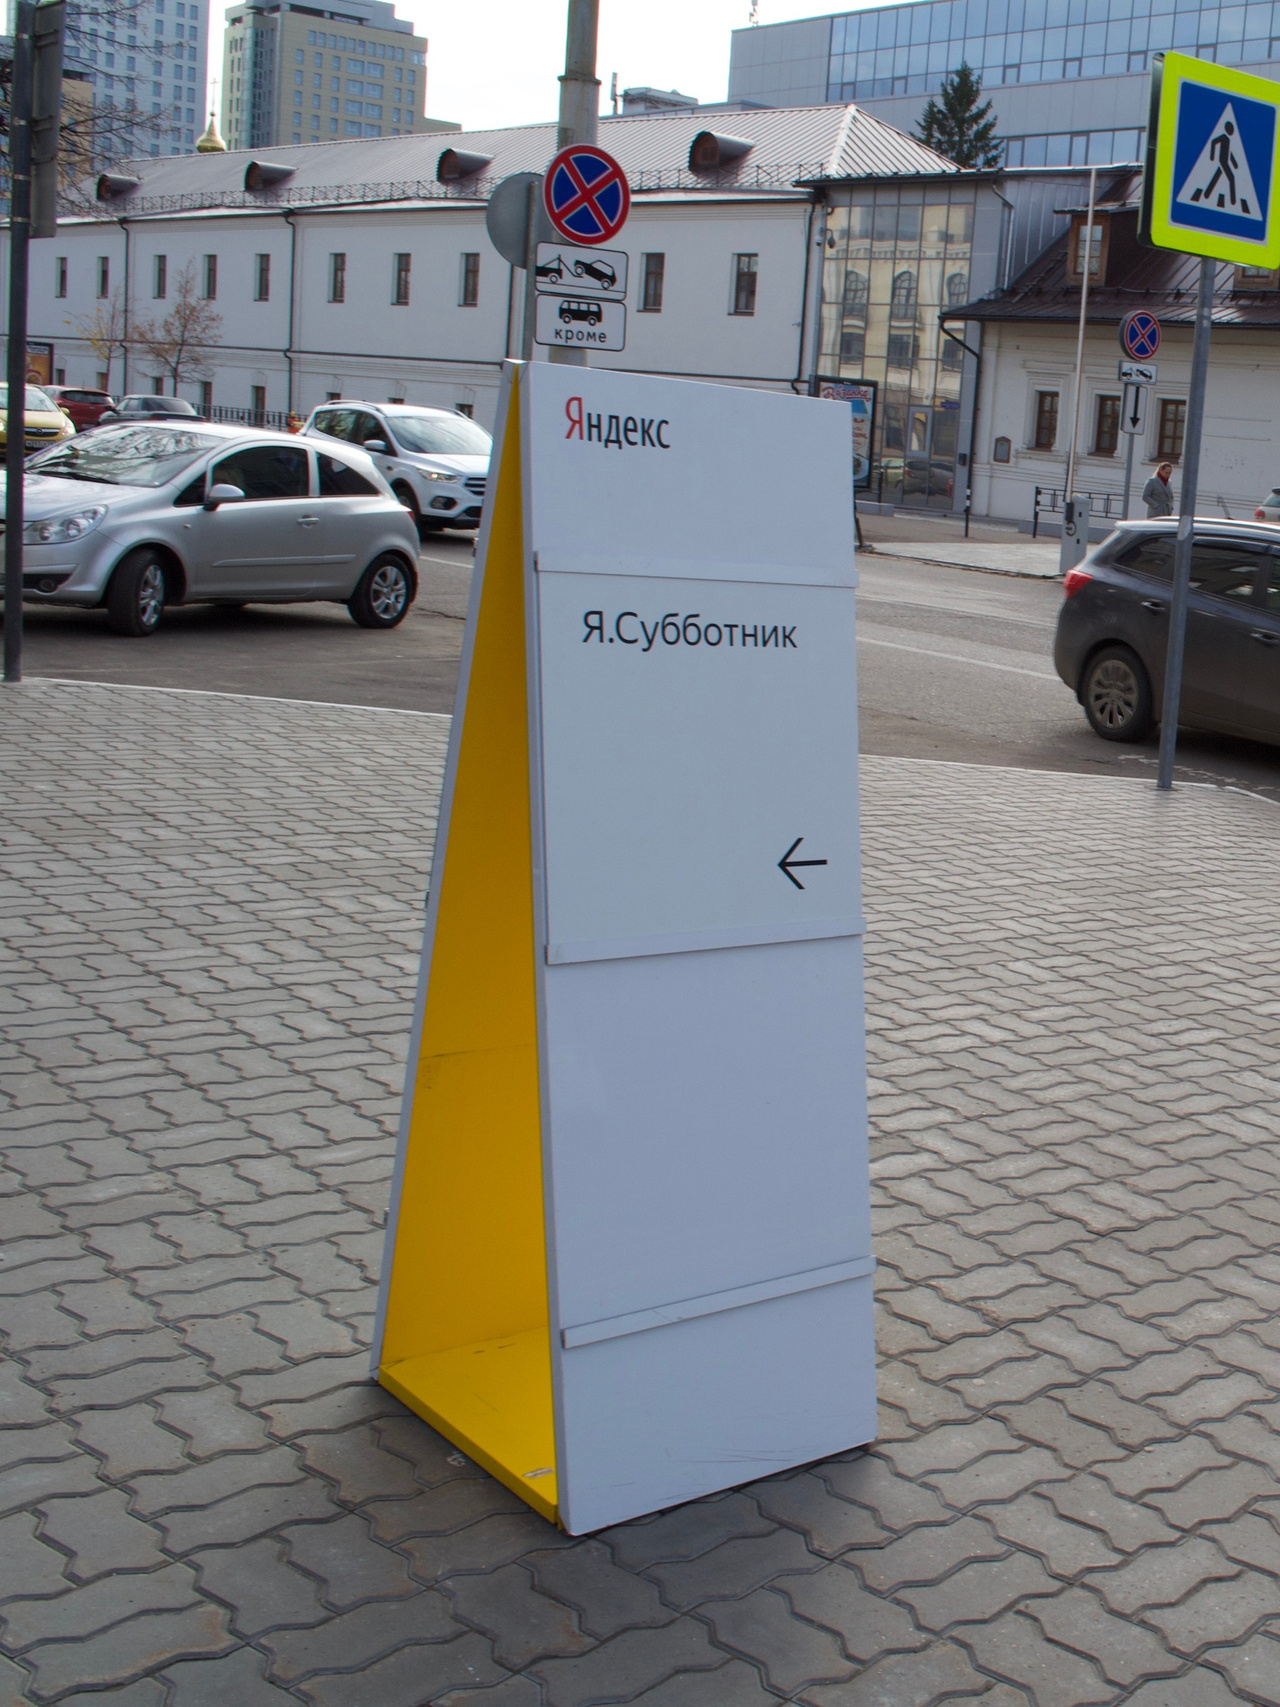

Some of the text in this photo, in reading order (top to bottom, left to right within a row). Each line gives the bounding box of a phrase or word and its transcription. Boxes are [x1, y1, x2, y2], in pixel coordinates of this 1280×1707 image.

[554, 328, 607, 344] кроме
[564, 396, 671, 450] Яндекс
[582, 610, 798, 652] Я.Субботник
